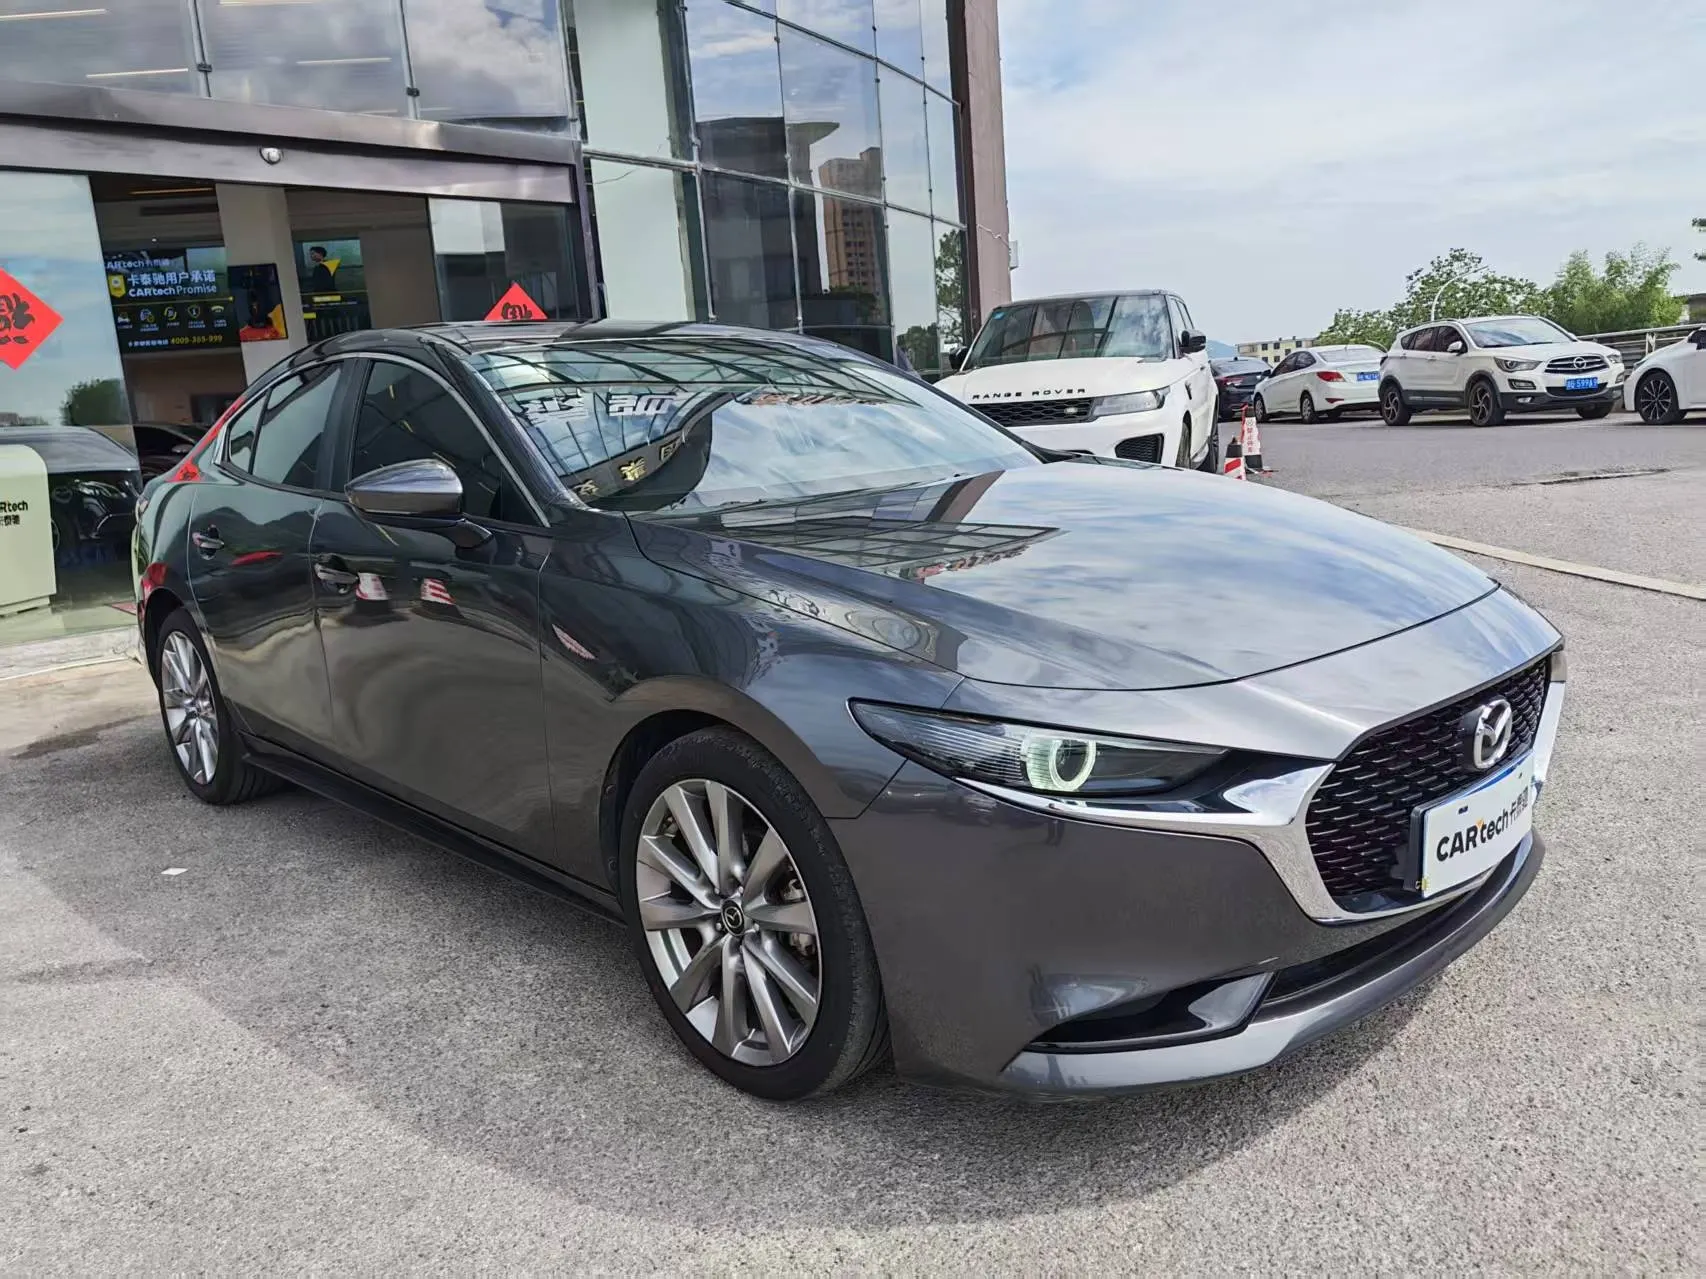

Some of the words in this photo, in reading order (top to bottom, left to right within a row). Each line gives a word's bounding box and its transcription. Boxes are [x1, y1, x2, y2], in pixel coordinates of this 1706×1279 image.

[127, 269, 216, 287] 卡泰驰用户承诺
[128, 286, 175, 297] CARtech
[176, 284, 217, 295] Promise
[972, 391, 1022, 400] RANGE
[1031, 388, 1086, 397] ROVER
[1436, 808, 1509, 862] CARtech
